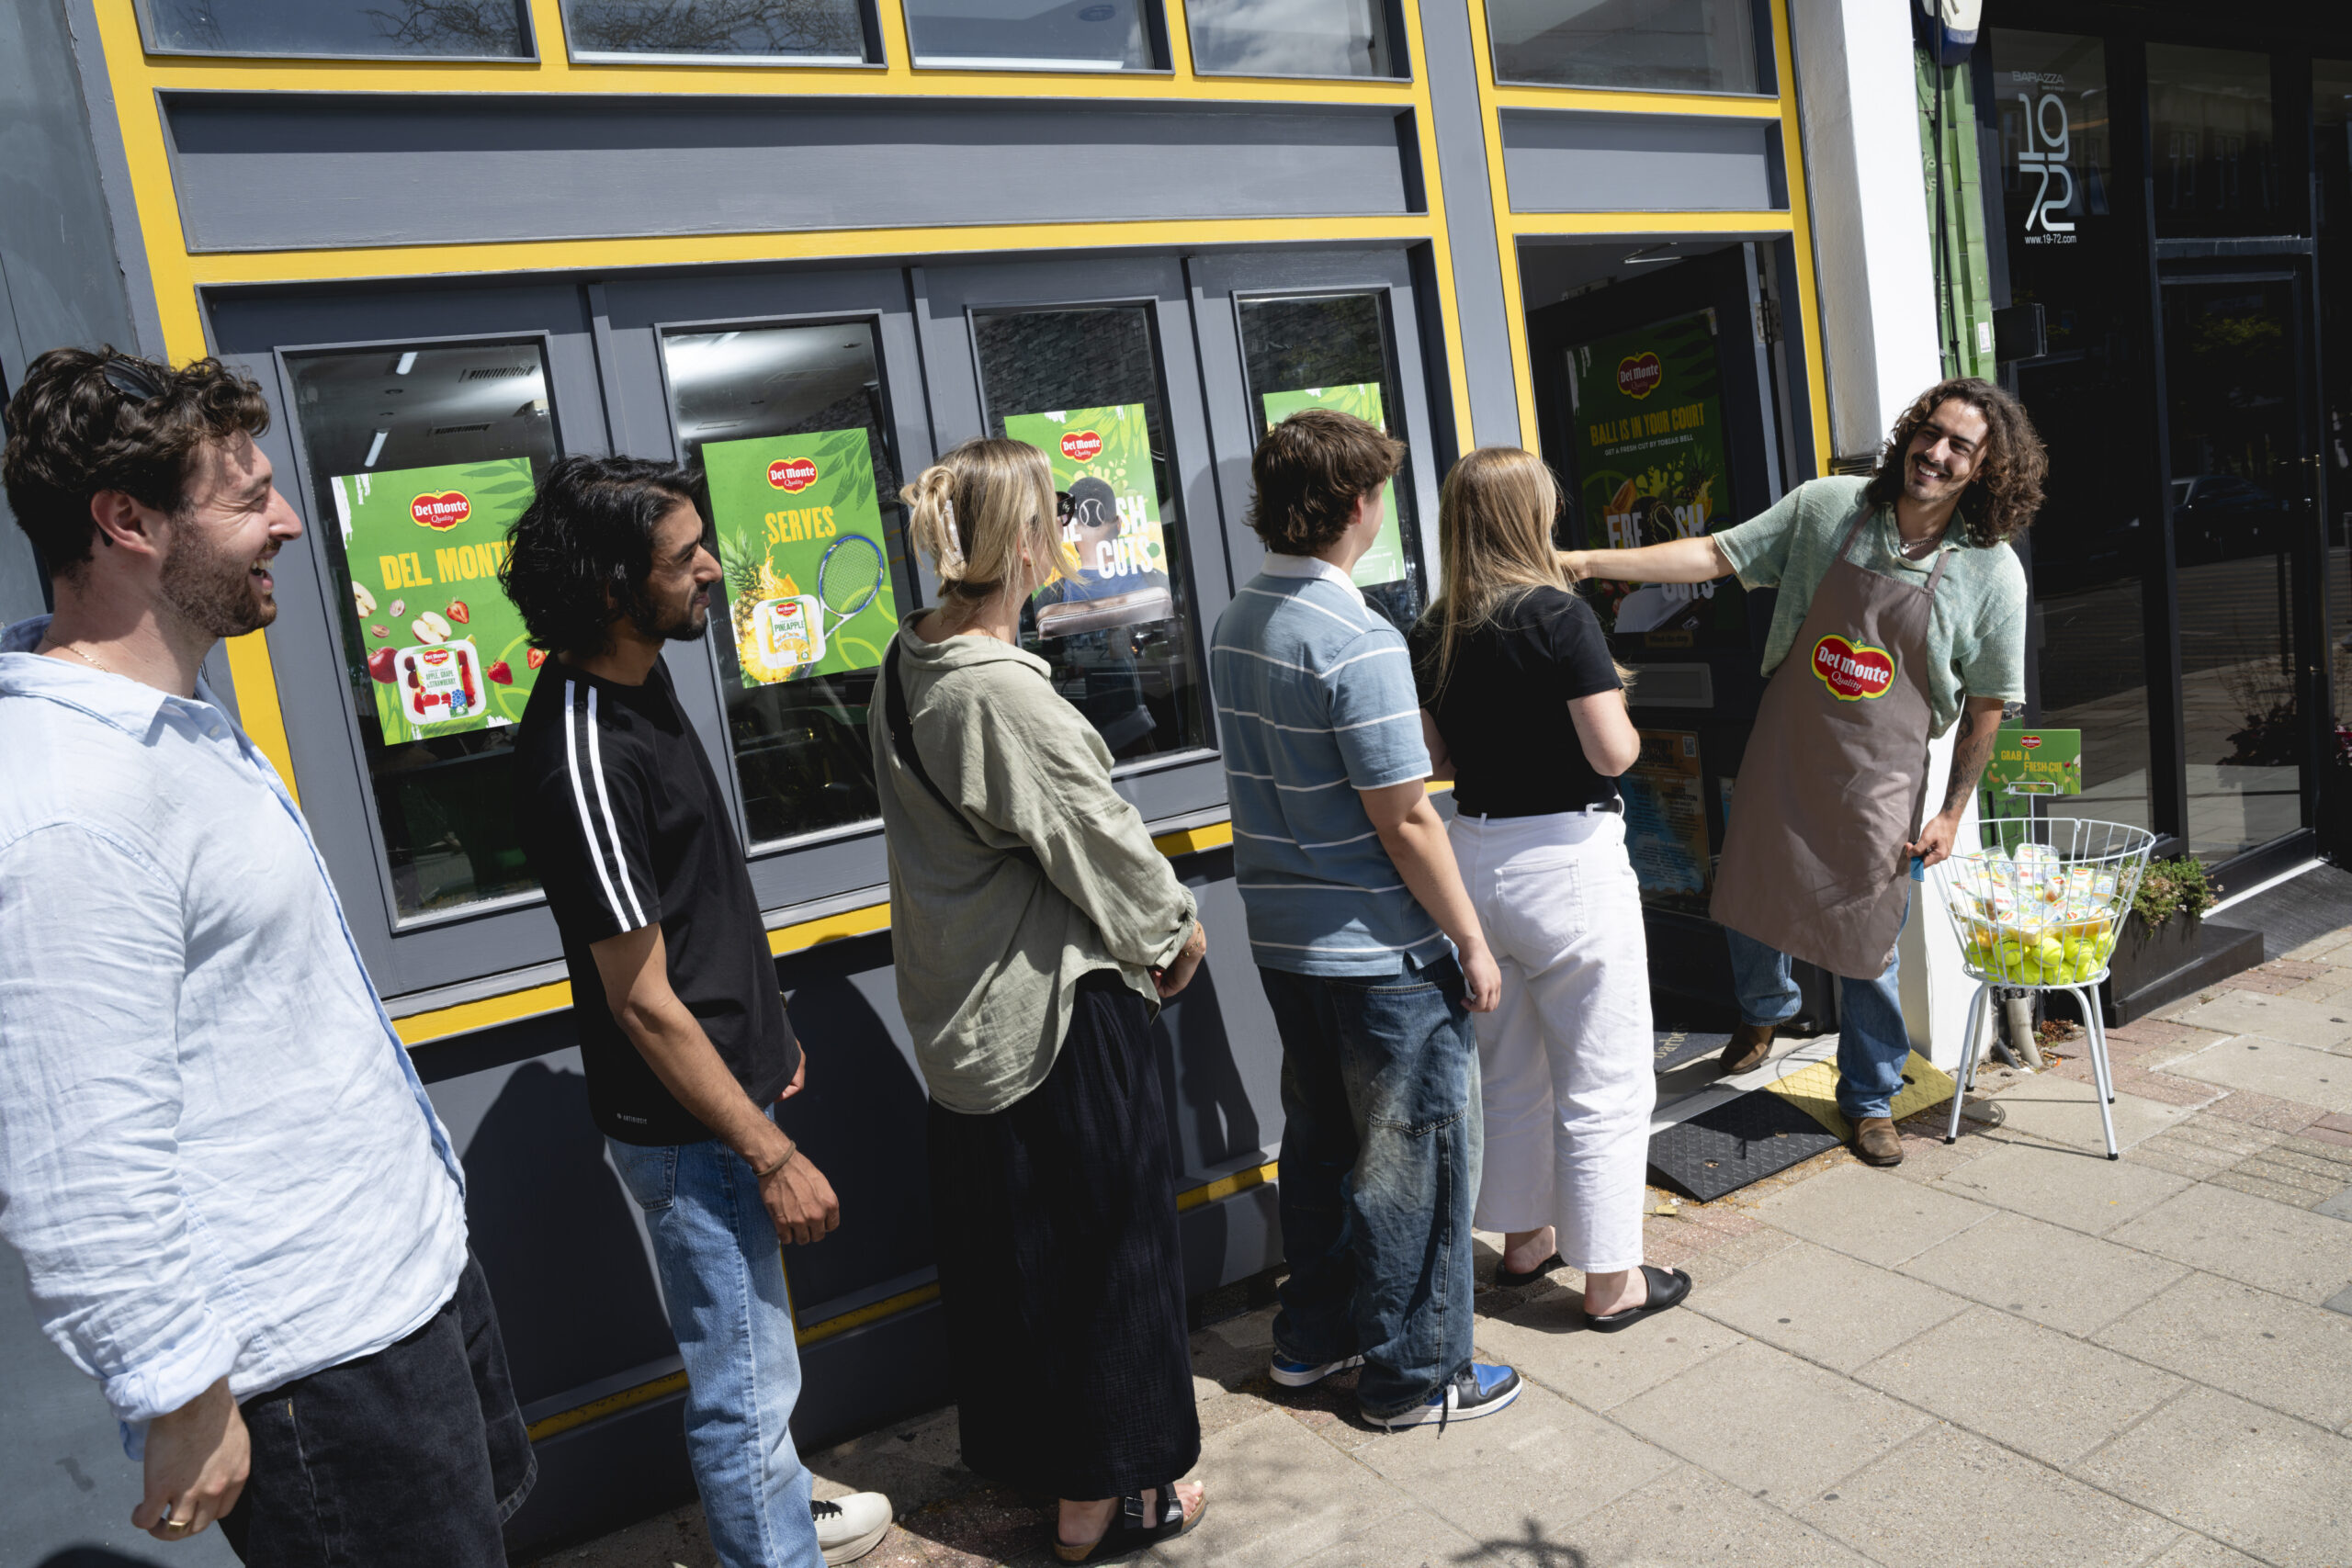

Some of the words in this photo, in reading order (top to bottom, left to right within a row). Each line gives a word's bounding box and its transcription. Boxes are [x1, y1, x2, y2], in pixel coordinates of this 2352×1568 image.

[2012, 71, 2064, 84] BARAZZA
[2018, 94, 2069, 161] 19
[2019, 164, 2075, 231] 72
[2025, 234, 2076, 244] www.19-72.com
[1620, 370, 1633, 383] Del
[1633, 364, 1658, 379] Monte
[1589, 421, 1618, 446] BALL
[1619, 419, 1630, 441] IS
[1631, 415, 1643, 438] IN
[1643, 410, 1670, 436] YOUR
[1671, 402, 1704, 432] COURT
[1063, 441, 1077, 451] Del
[1077, 438, 1101, 449] Monte
[1604, 448, 1615, 457] GET
[1620, 444, 1637, 453] FRESH
[1637, 442, 1649, 450] CUT
[1657, 437, 1679, 447] TOBIAS
[1679, 434, 1693, 442] BELL
[1075, 449, 1091, 457] Quality
[770, 468, 786, 480] Del
[786, 466, 815, 479] Monte
[784, 478, 804, 488] Quality
[413, 502, 433, 516] Del
[434, 500, 468, 514] Monte
[431, 513, 455, 524] Quality
[764, 505, 836, 544] SERVES
[1096, 536, 1153, 580] CUTS
[379, 552, 432, 591] DEL
[775, 620, 805, 632] PINEAPPLE
[1817, 646, 1840, 669] Del
[1840, 657, 1889, 684] Monte
[1831, 671, 1861, 692] Quality
[2001, 750, 2022, 761] GRAB
[2024, 750, 2030, 761] A
[2024, 761, 2047, 773] FRESH
[2049, 761, 2063, 773] CUT
